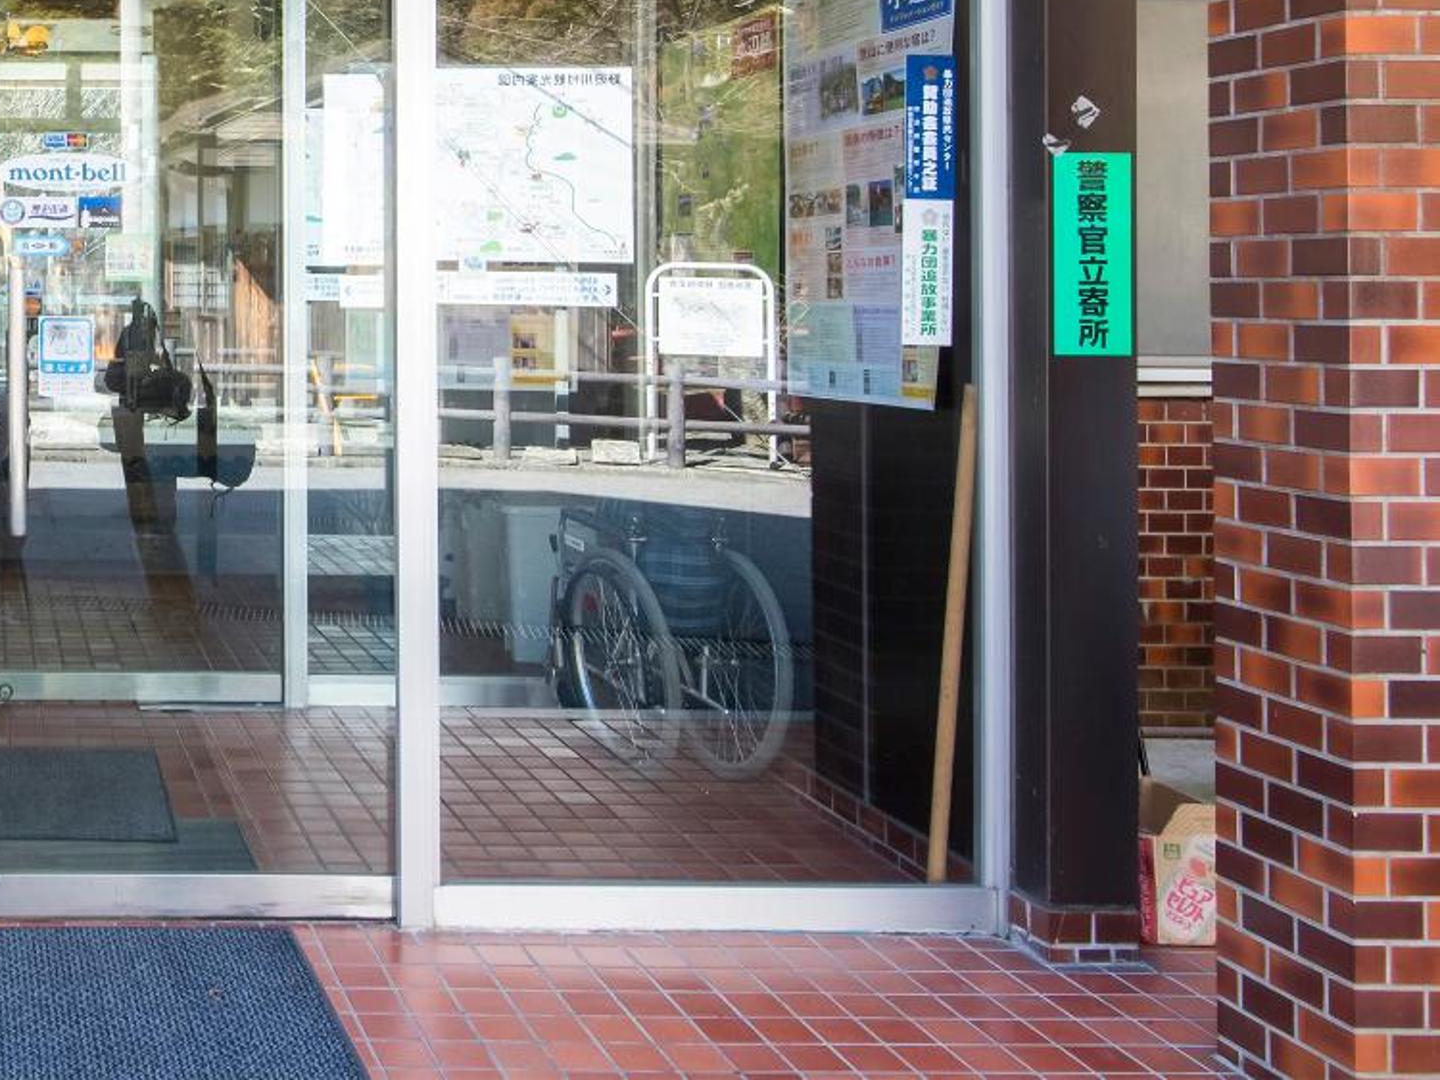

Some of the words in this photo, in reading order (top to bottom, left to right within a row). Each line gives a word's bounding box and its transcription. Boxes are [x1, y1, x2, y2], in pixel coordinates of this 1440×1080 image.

[1076, 160, 1110, 350] 警察官立寄所
